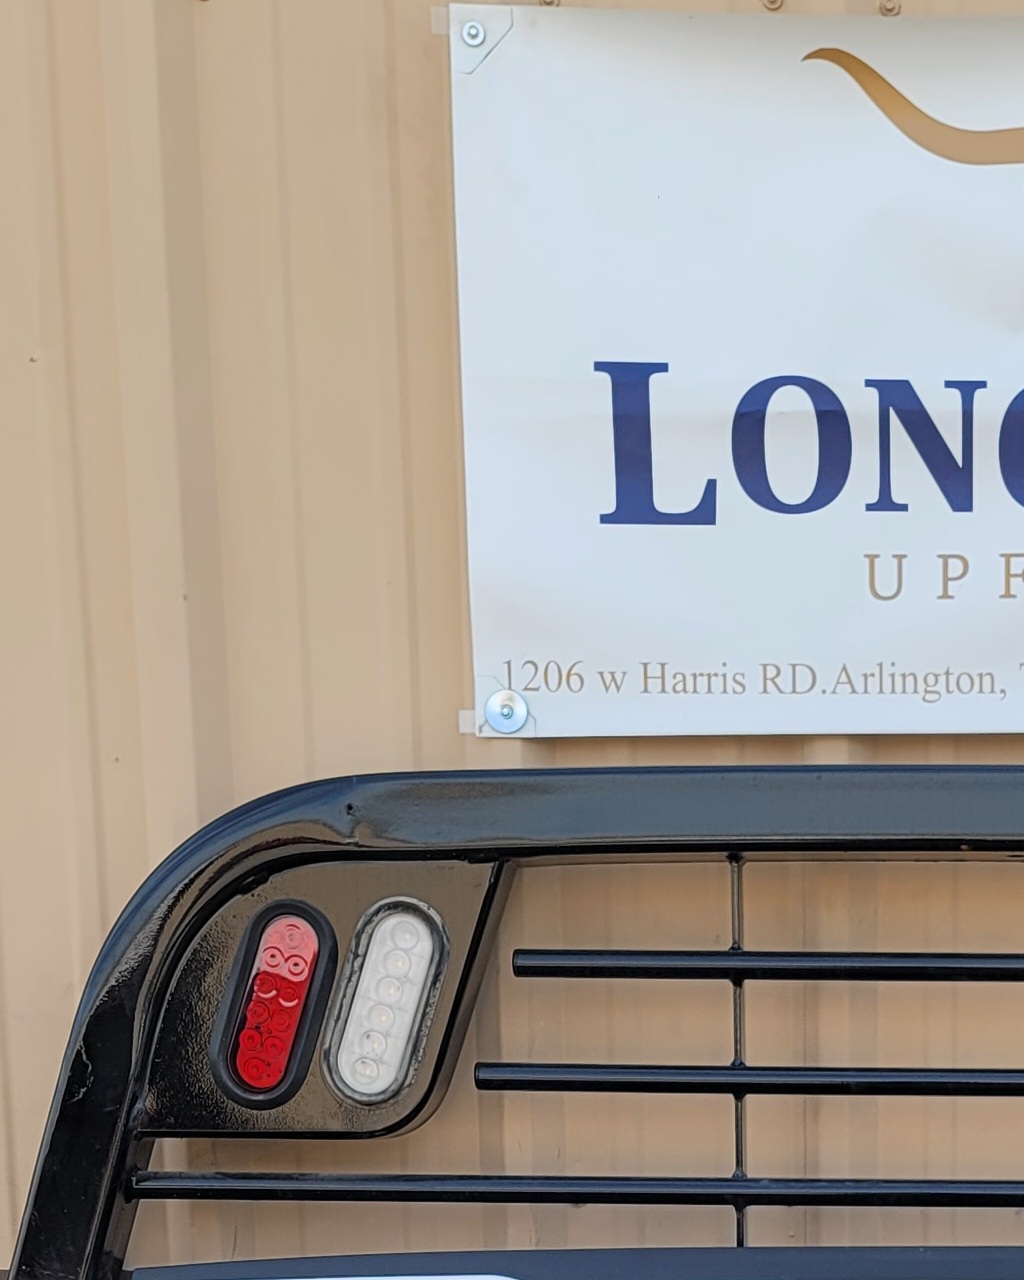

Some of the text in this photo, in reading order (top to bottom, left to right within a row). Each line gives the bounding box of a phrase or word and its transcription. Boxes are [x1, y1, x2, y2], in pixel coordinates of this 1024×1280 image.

[502, 659, 585, 693] 1206
[596, 670, 628, 694] w
[638, 660, 747, 695] Harris
